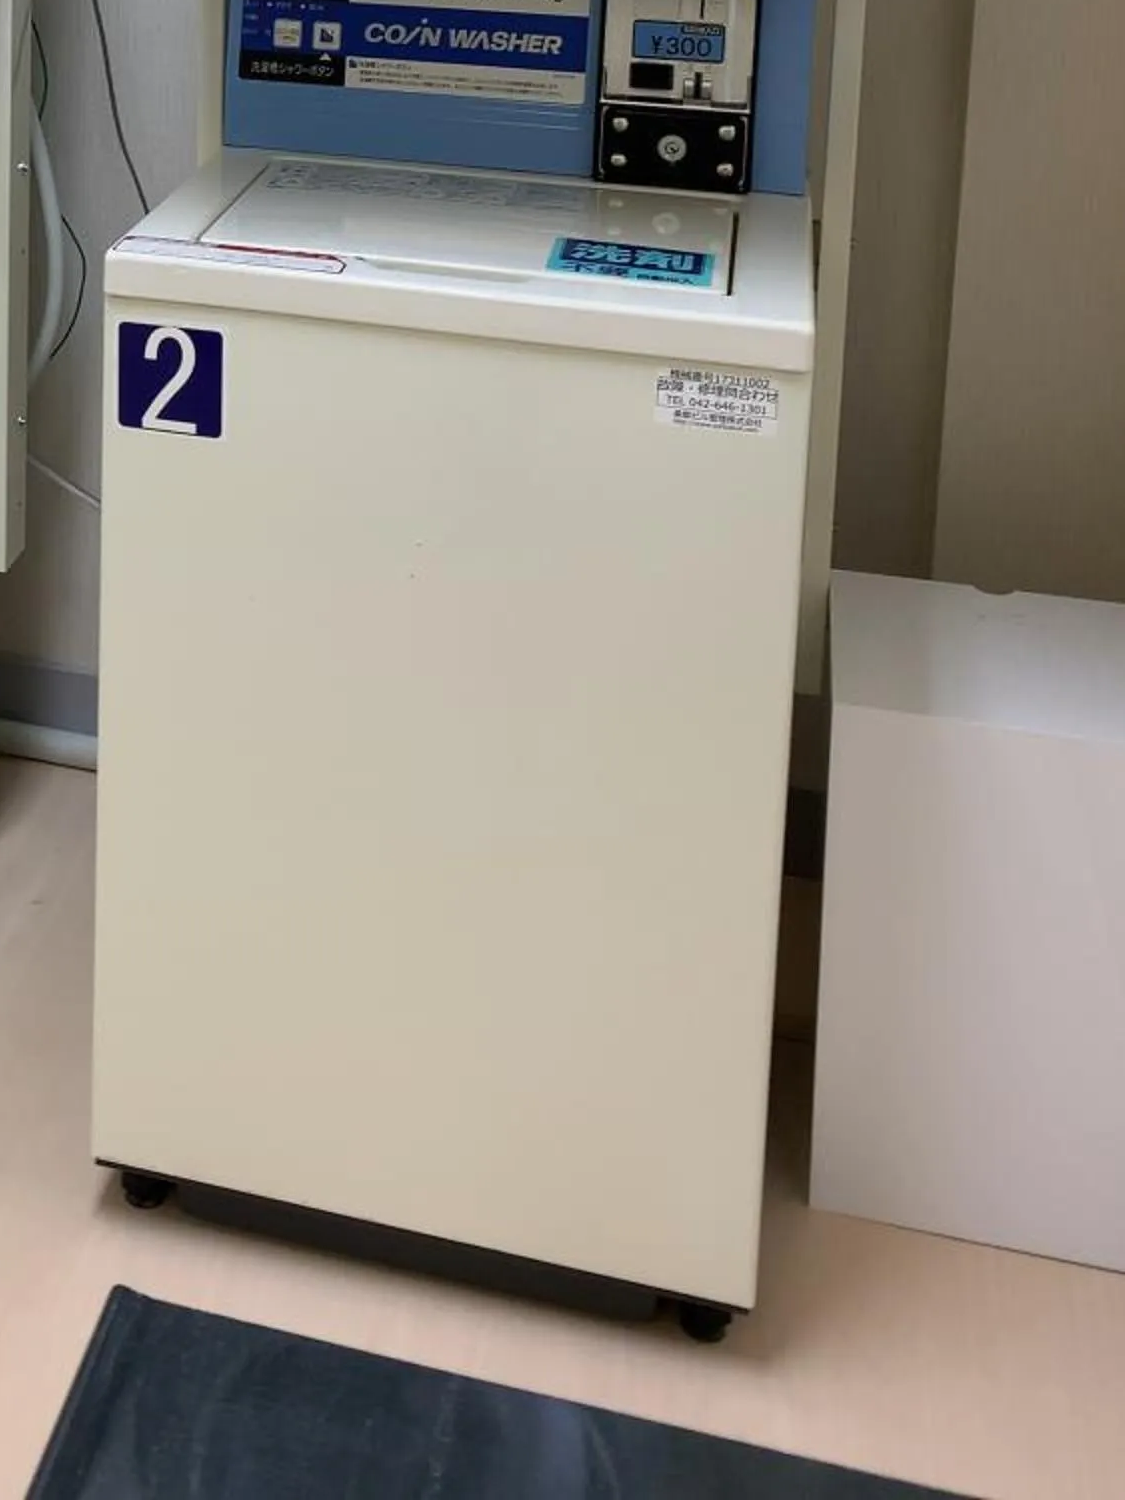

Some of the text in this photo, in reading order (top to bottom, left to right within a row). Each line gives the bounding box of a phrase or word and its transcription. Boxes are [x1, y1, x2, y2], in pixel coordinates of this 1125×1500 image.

[364, 17, 564, 55] COIN WASHER
[651, 35, 712, 57] ¥300
[570, 241, 694, 271] 洗剤
[141, 326, 197, 434] 2
[688, 397, 767, 415] 042-646-1301
